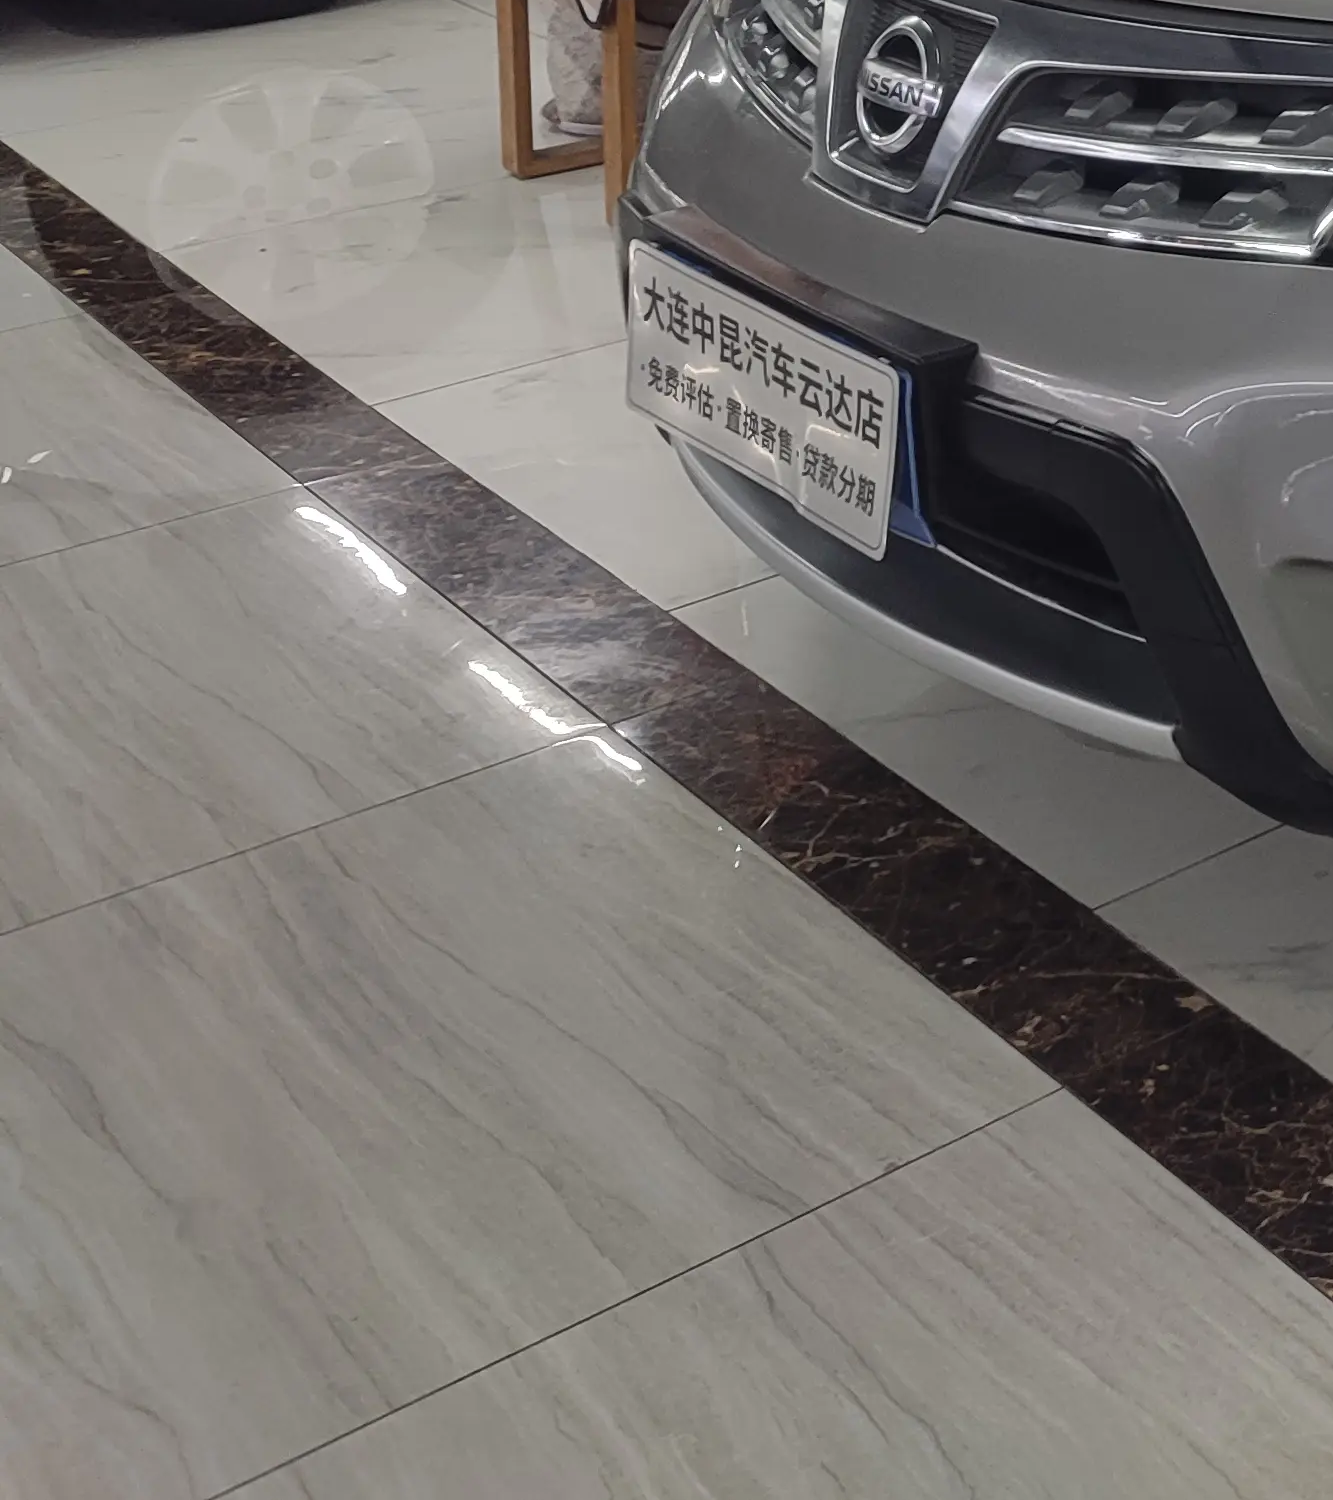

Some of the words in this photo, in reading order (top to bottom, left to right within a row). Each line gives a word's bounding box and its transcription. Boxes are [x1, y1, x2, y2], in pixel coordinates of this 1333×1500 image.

[643, 276, 885, 450] 大连中昆汽车云达店
